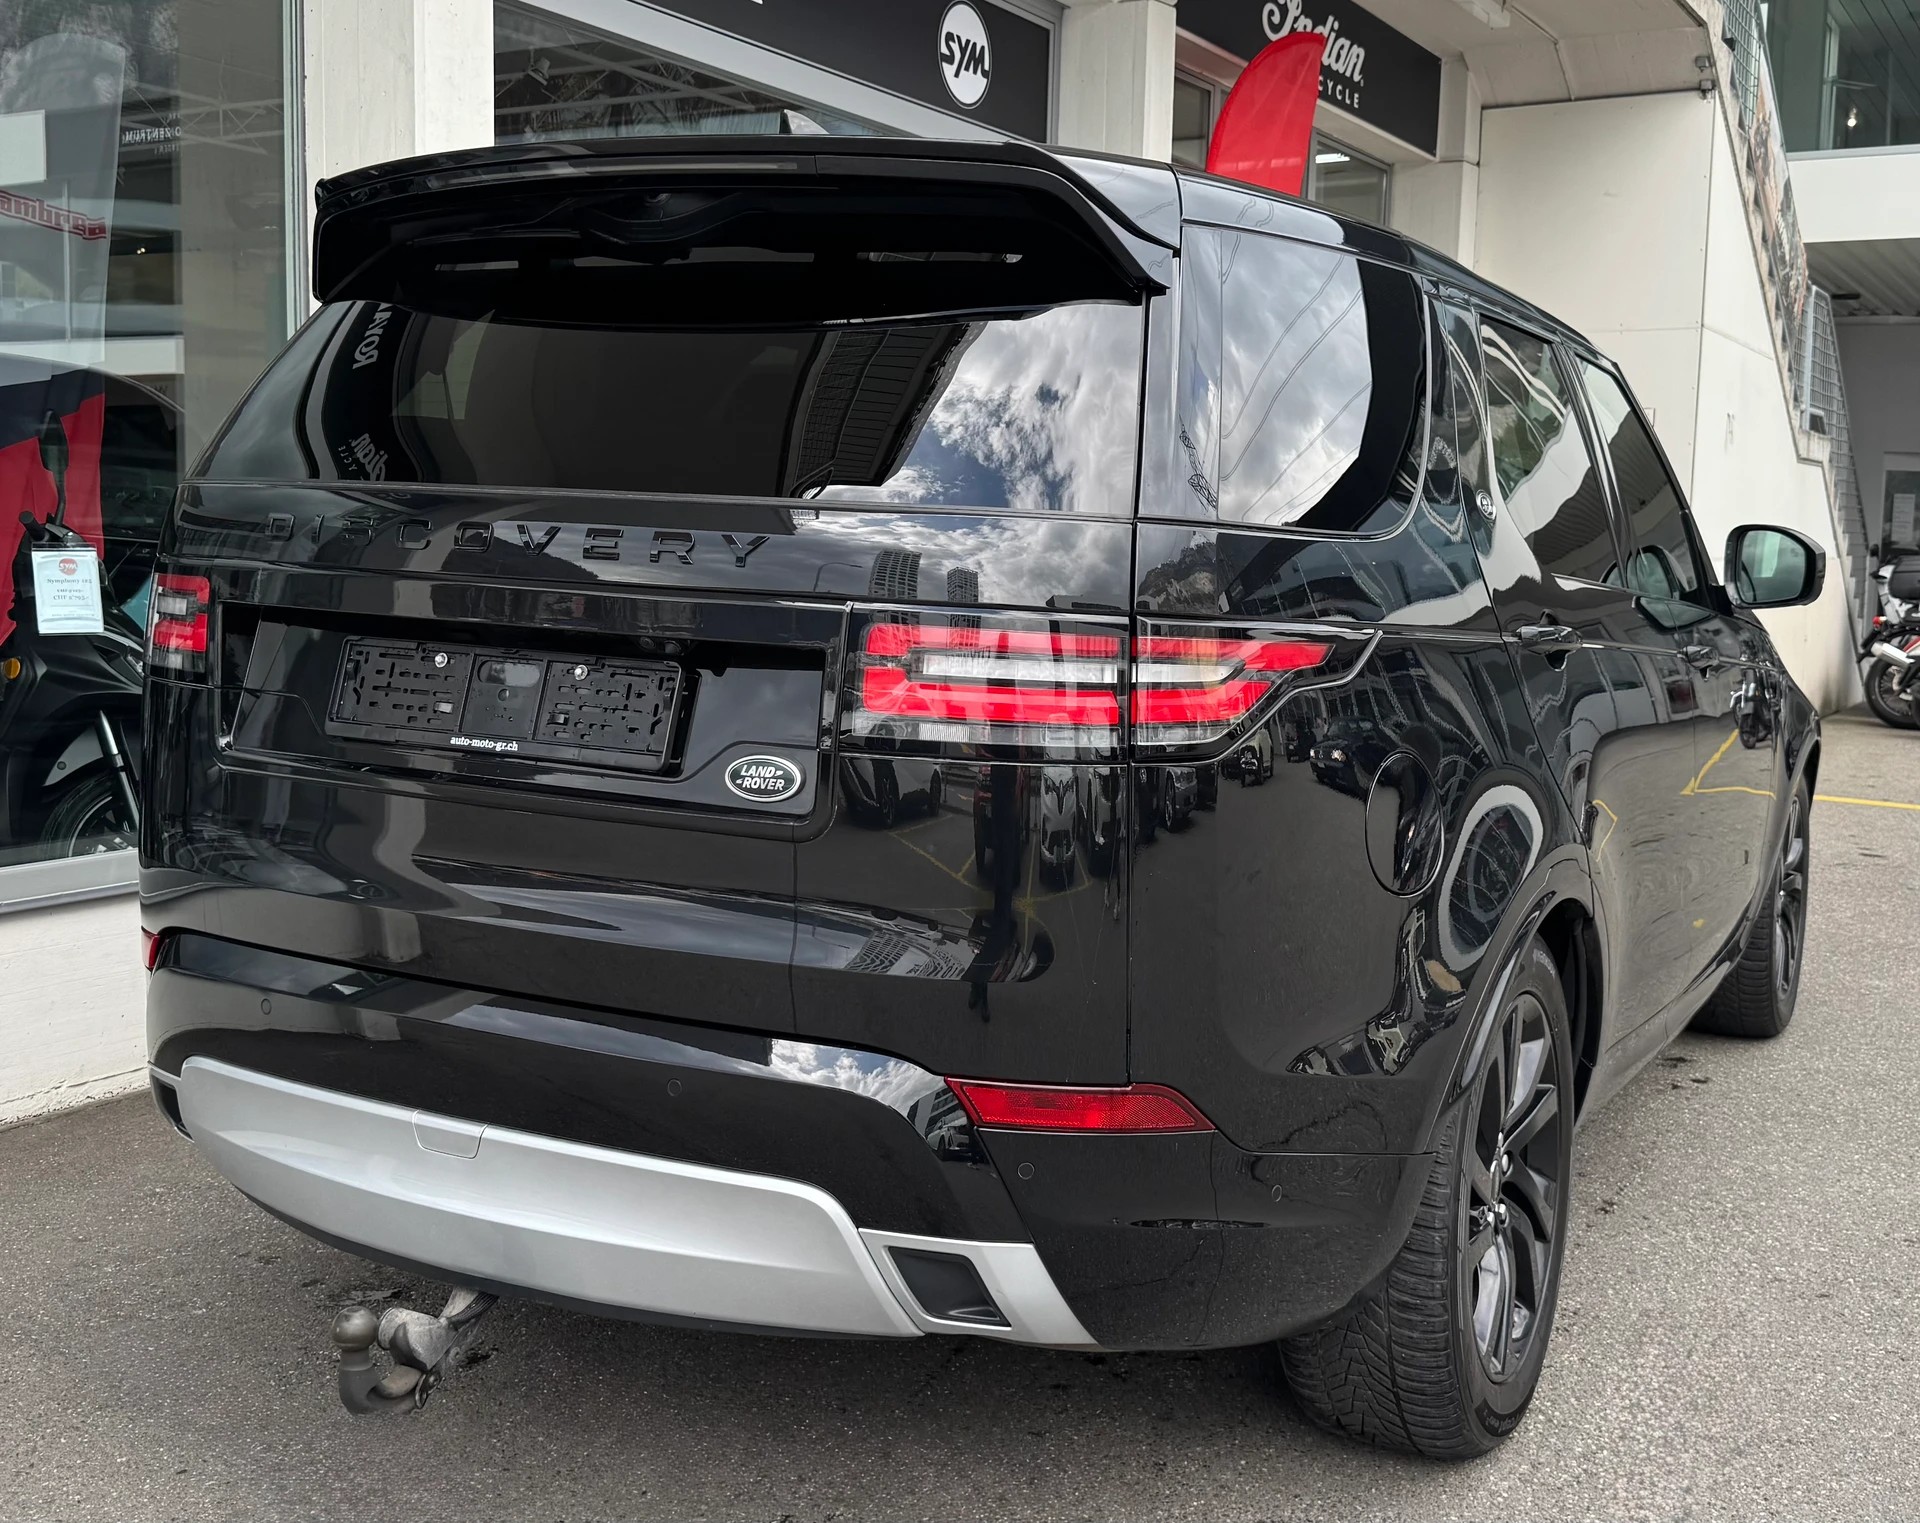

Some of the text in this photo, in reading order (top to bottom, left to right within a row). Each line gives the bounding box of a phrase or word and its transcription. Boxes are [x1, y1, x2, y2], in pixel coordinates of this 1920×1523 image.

[940, 31, 989, 79] SYM
[1317, 75, 1360, 108] CYCLE
[265, 512, 770, 568] DISCOVERY
[59, 563, 78, 572] SYM
[450, 736, 518, 752] auto-moto-gr.ch
[740, 764, 776, 778] LAND
[742, 777, 785, 791] ROVER
